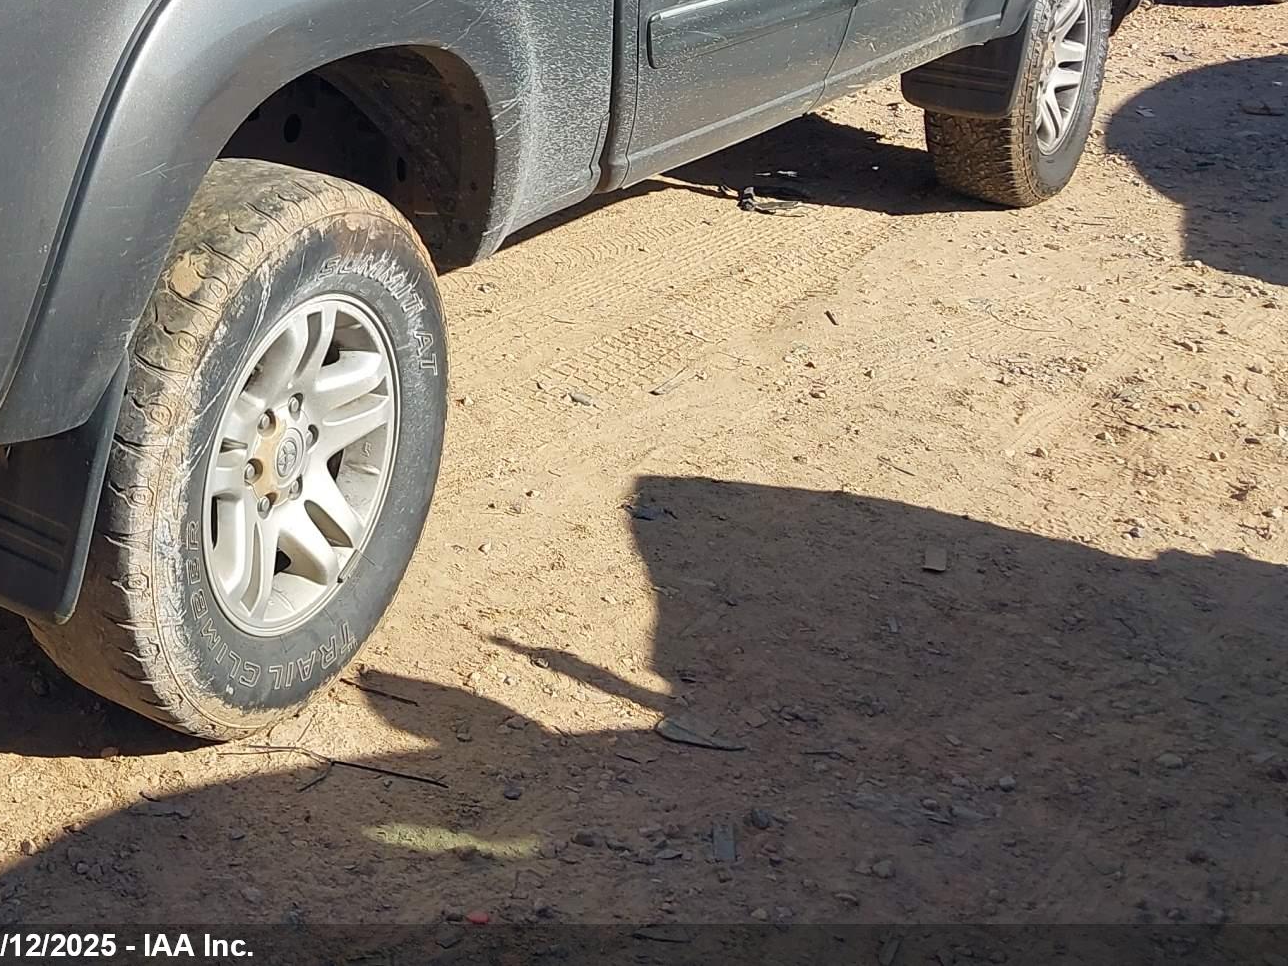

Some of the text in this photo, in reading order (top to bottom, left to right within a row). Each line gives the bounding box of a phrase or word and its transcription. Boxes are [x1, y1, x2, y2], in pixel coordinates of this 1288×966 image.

[316, 253, 438, 376] SUMMIT AT
[185, 520, 359, 691] TRAIL CLIMBER
